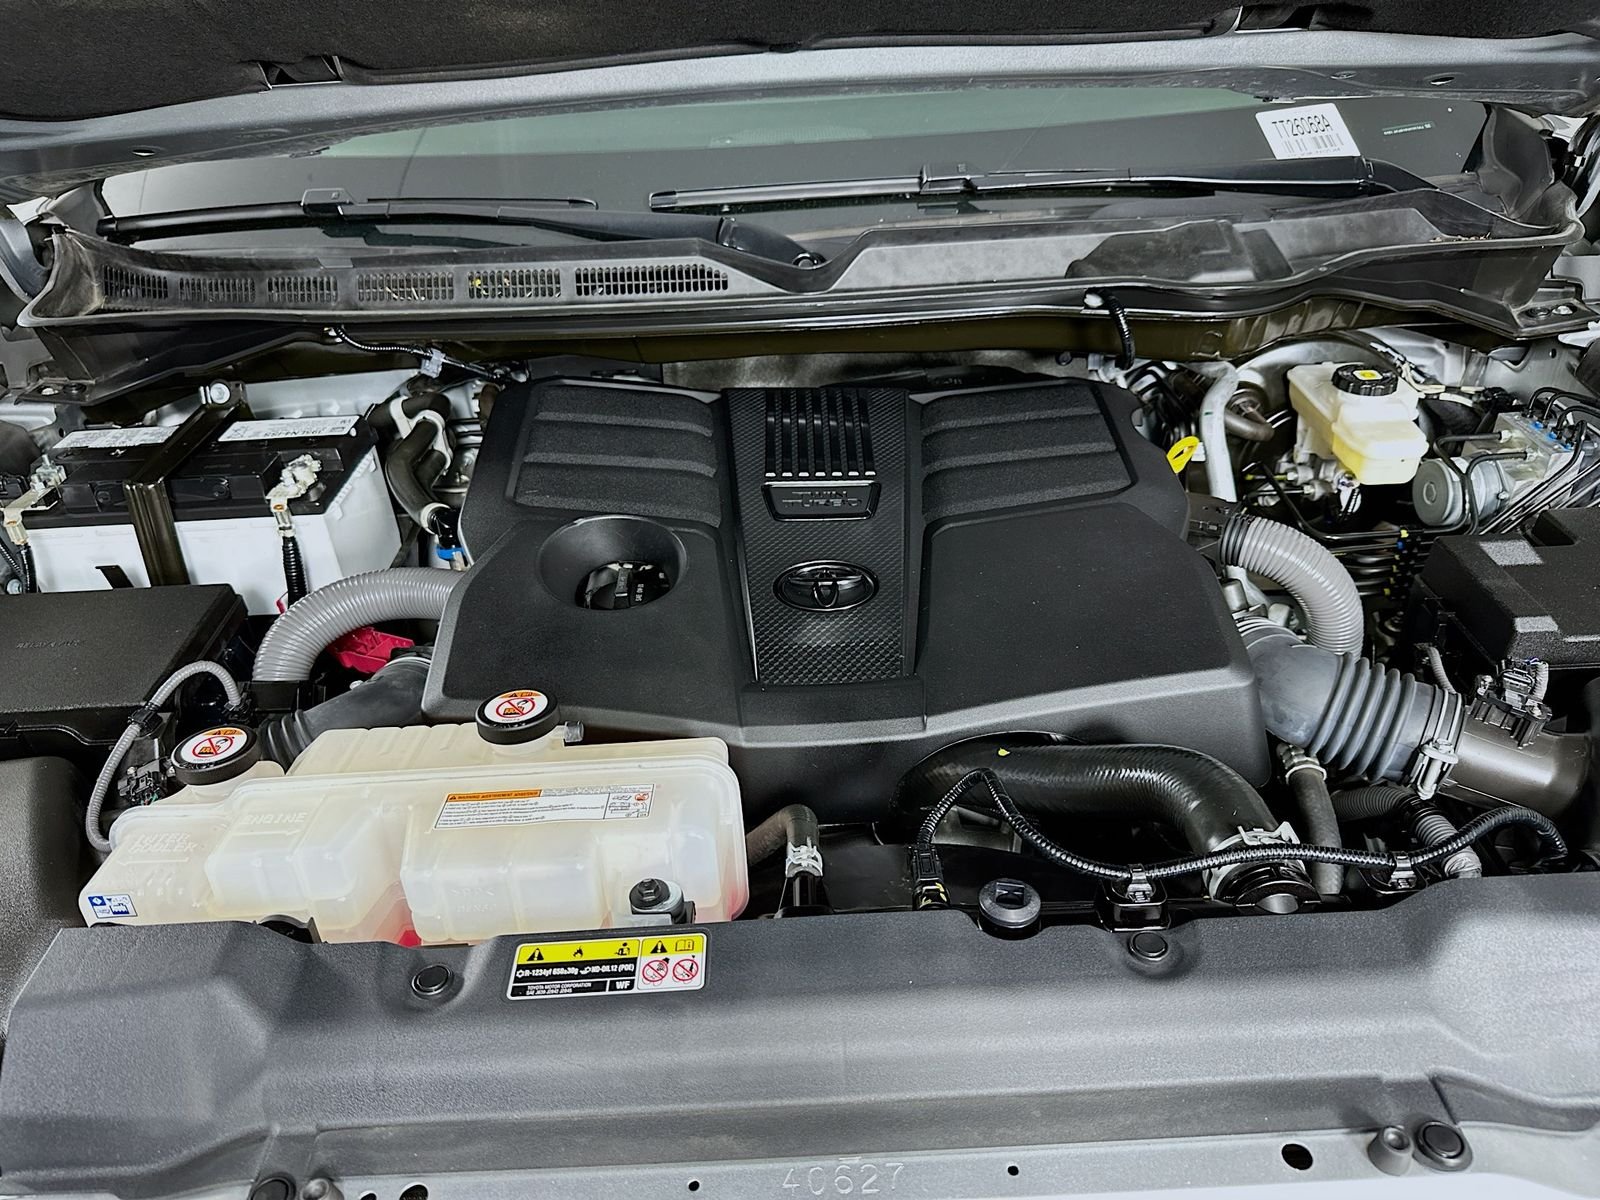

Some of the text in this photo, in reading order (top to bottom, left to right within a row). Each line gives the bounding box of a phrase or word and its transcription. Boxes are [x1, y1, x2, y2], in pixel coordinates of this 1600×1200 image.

[1271, 114, 1334, 138] TT26068A
[239, 811, 308, 825] ENGINE
[524, 968, 552, 977] R-1234yf
[615, 981, 631, 989] WF
